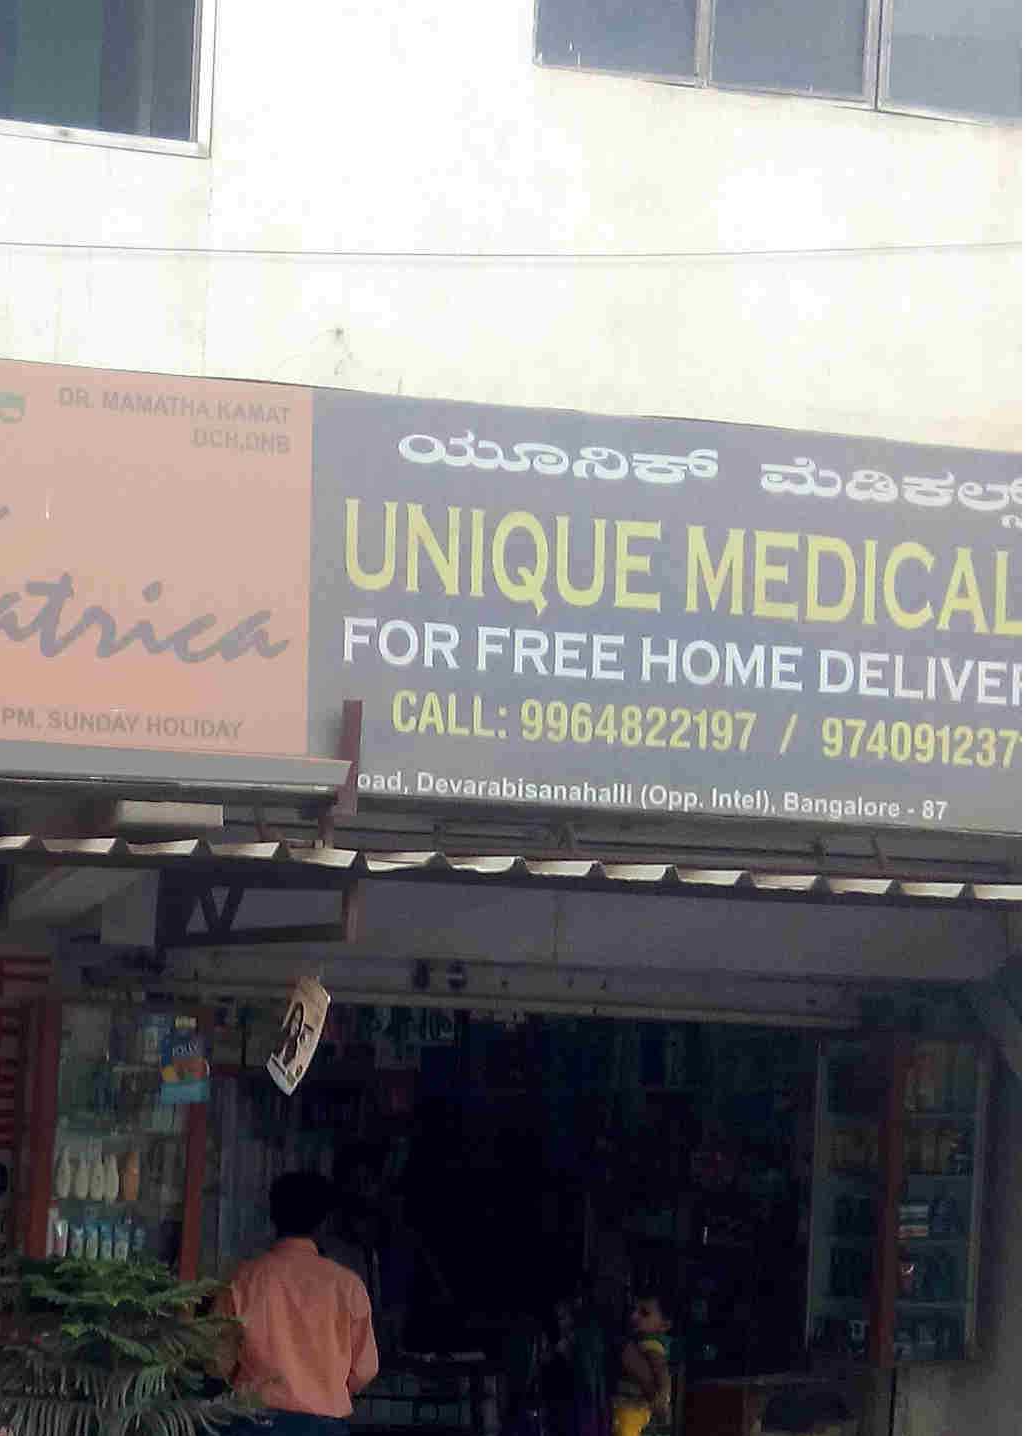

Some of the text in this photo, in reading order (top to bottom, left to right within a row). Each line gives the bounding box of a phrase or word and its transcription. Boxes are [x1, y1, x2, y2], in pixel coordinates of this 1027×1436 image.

[58, 386, 292, 425] DR. MAMATHA KAMAT
[344, 498, 662, 616] UNIQUE
[342, 617, 460, 670] FOR
[476, 626, 625, 681] FREE
[640, 639, 804, 693] HOME
[47, 710, 139, 735] SUNDAY
[146, 715, 244, 741] HOLIDAY
[392, 690, 507, 740] CALL:
[519, 697, 758, 754] 9964822197
[780, 714, 796, 754] /
[417, 771, 632, 805] Devarabisanahalli
[641, 784, 704, 812] (Opp.
[711, 787, 775, 815] Intel),
[783, 791, 900, 819] Bangalore
[922, 800, 948, 820] 87
